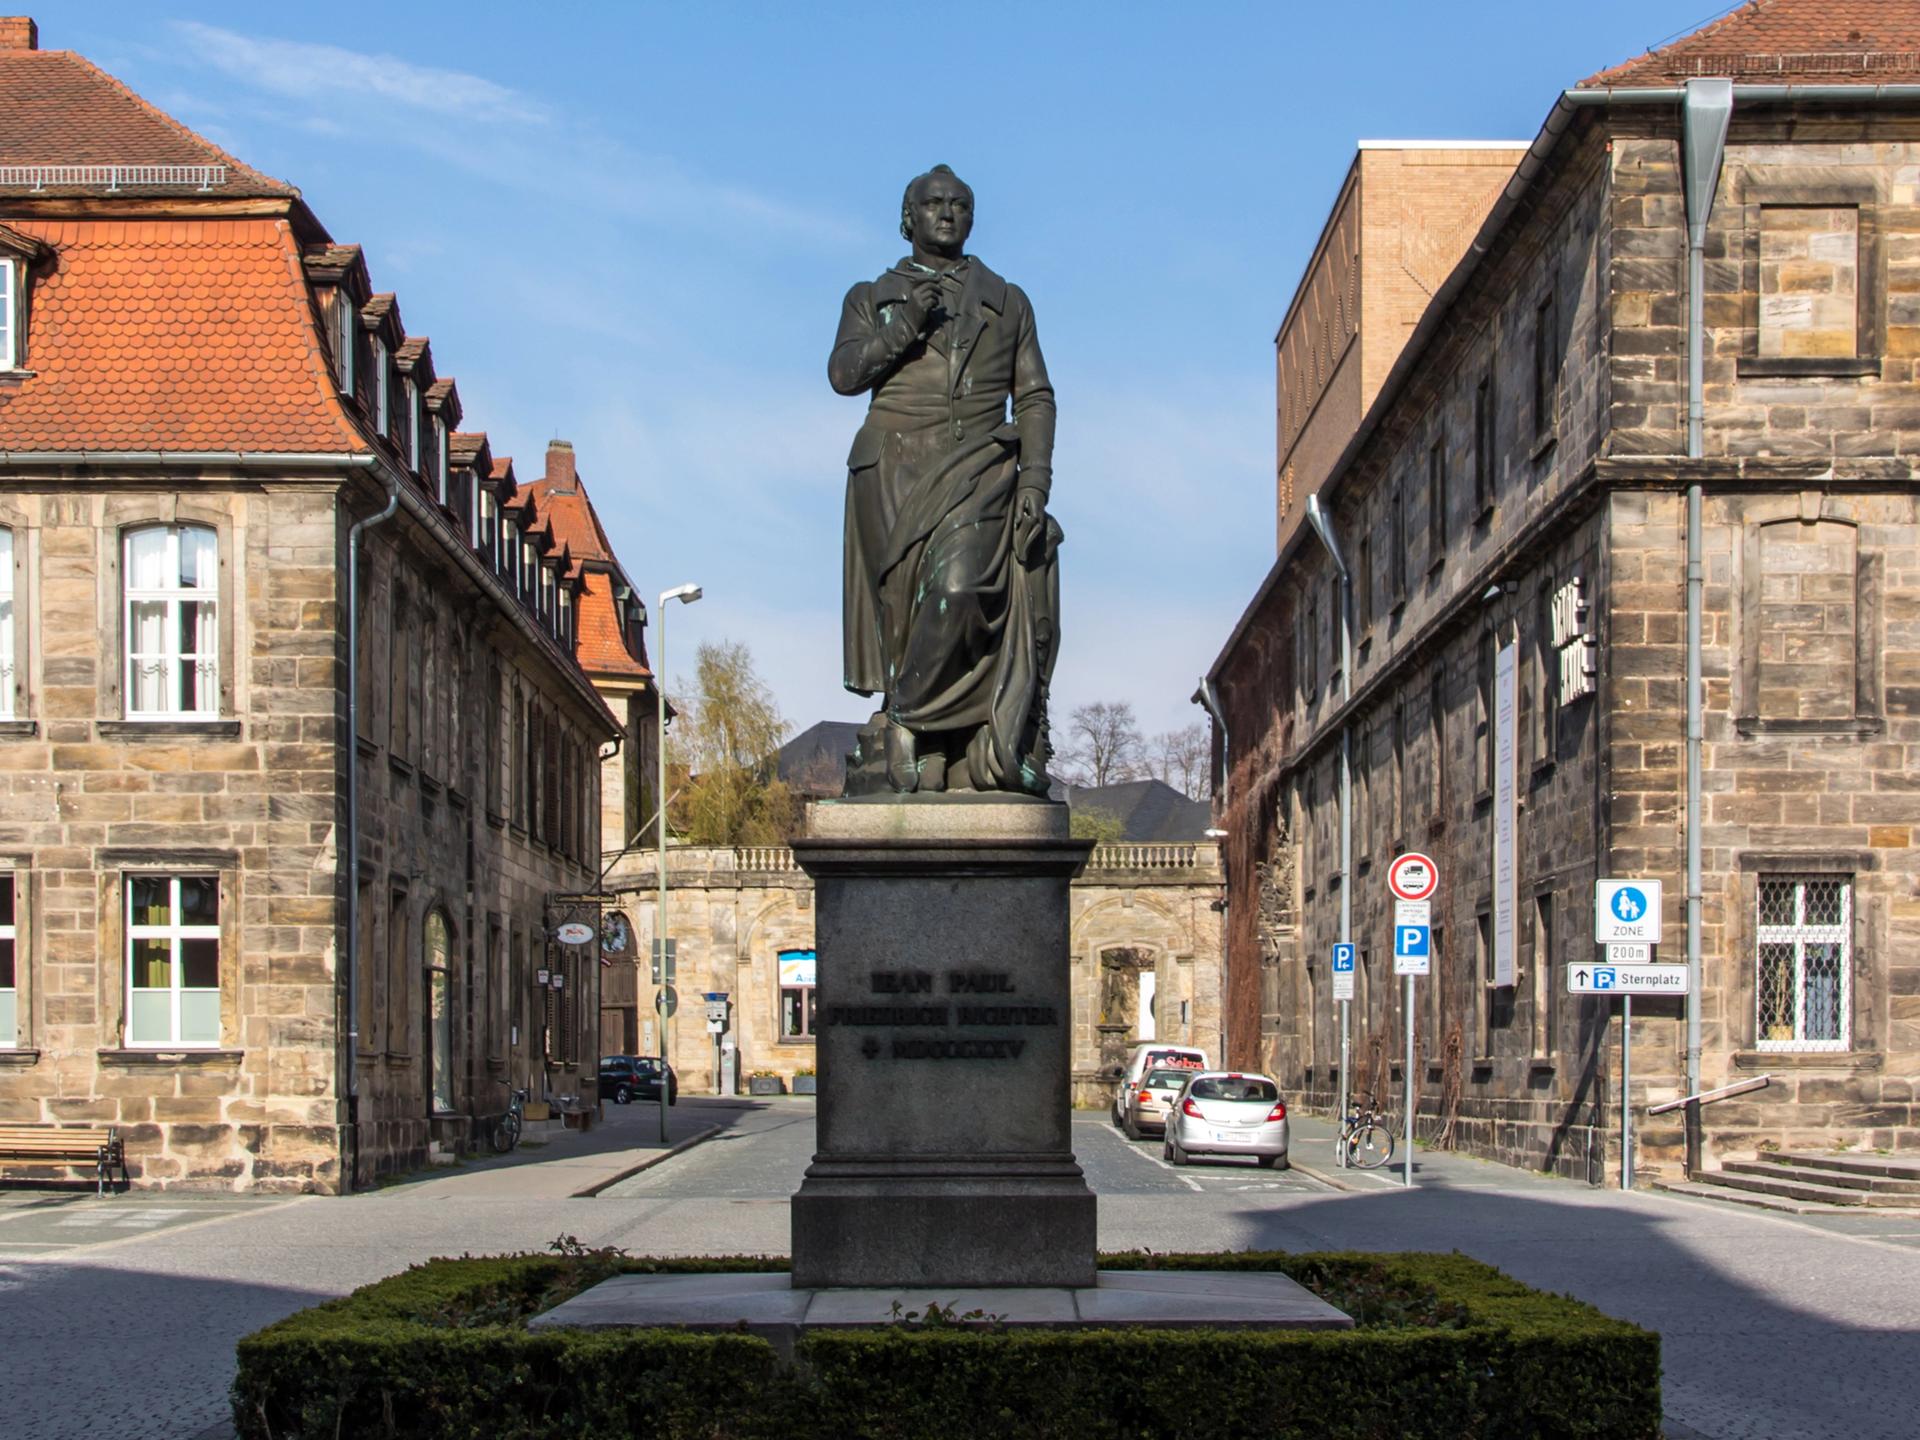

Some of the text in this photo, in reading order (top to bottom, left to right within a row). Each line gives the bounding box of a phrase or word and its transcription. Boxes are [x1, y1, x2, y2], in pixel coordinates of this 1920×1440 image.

[1613, 926, 1644, 936] ZONE
[1403, 928, 1422, 954] P
[1338, 947, 1350, 969] P
[950, 973, 1015, 993] PAUL
[1621, 974, 1680, 987] Sternplatz
[958, 1006, 1059, 1025] RICHTER
